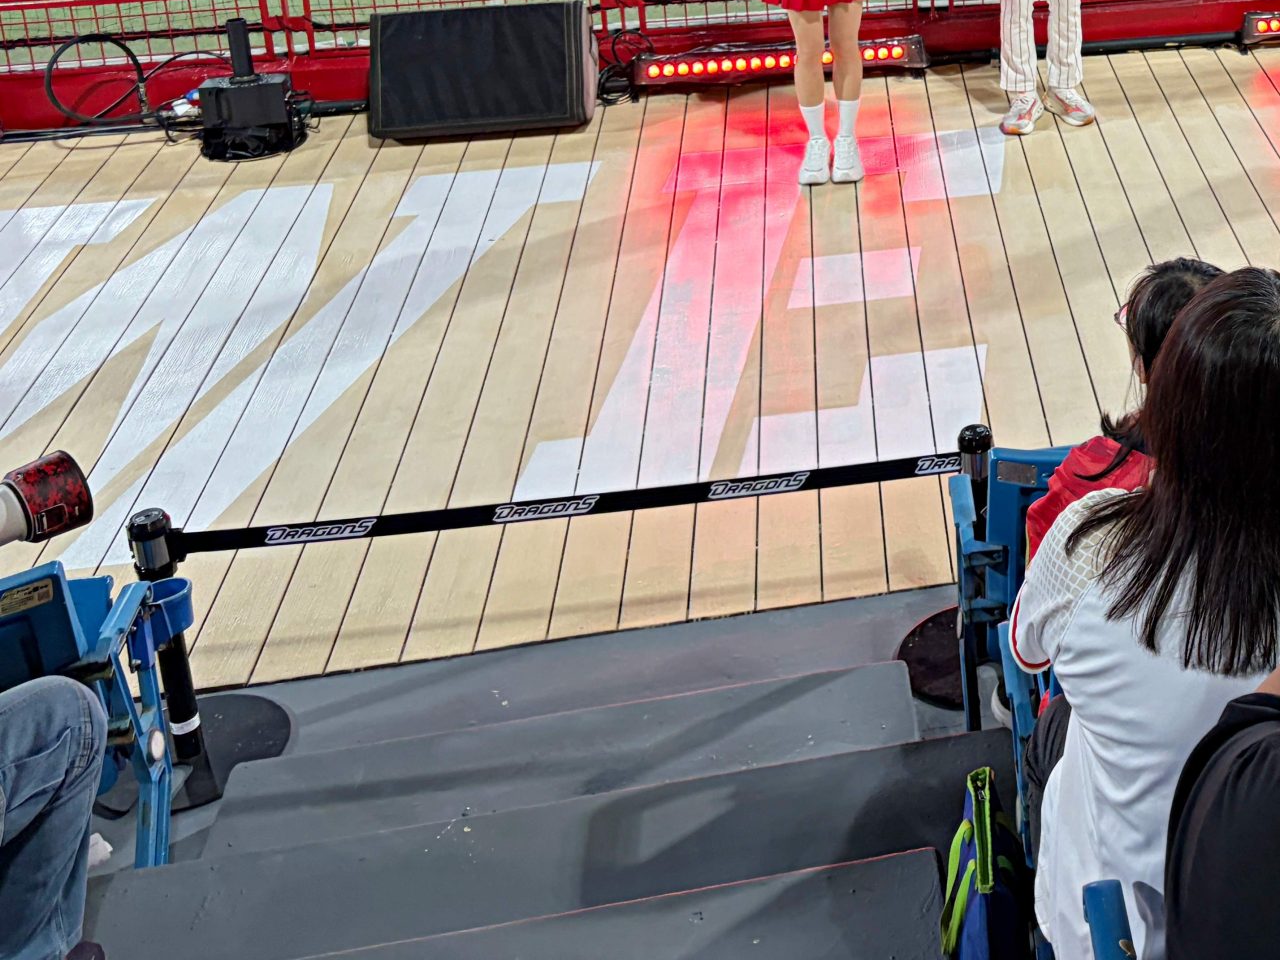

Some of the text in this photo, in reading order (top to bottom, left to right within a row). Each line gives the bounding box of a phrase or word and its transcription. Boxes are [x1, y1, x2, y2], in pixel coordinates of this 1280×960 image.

[708, 471, 811, 499] DRAGONS
[492, 495, 601, 523] DRAGONS
[265, 517, 377, 545] DRAGONS
